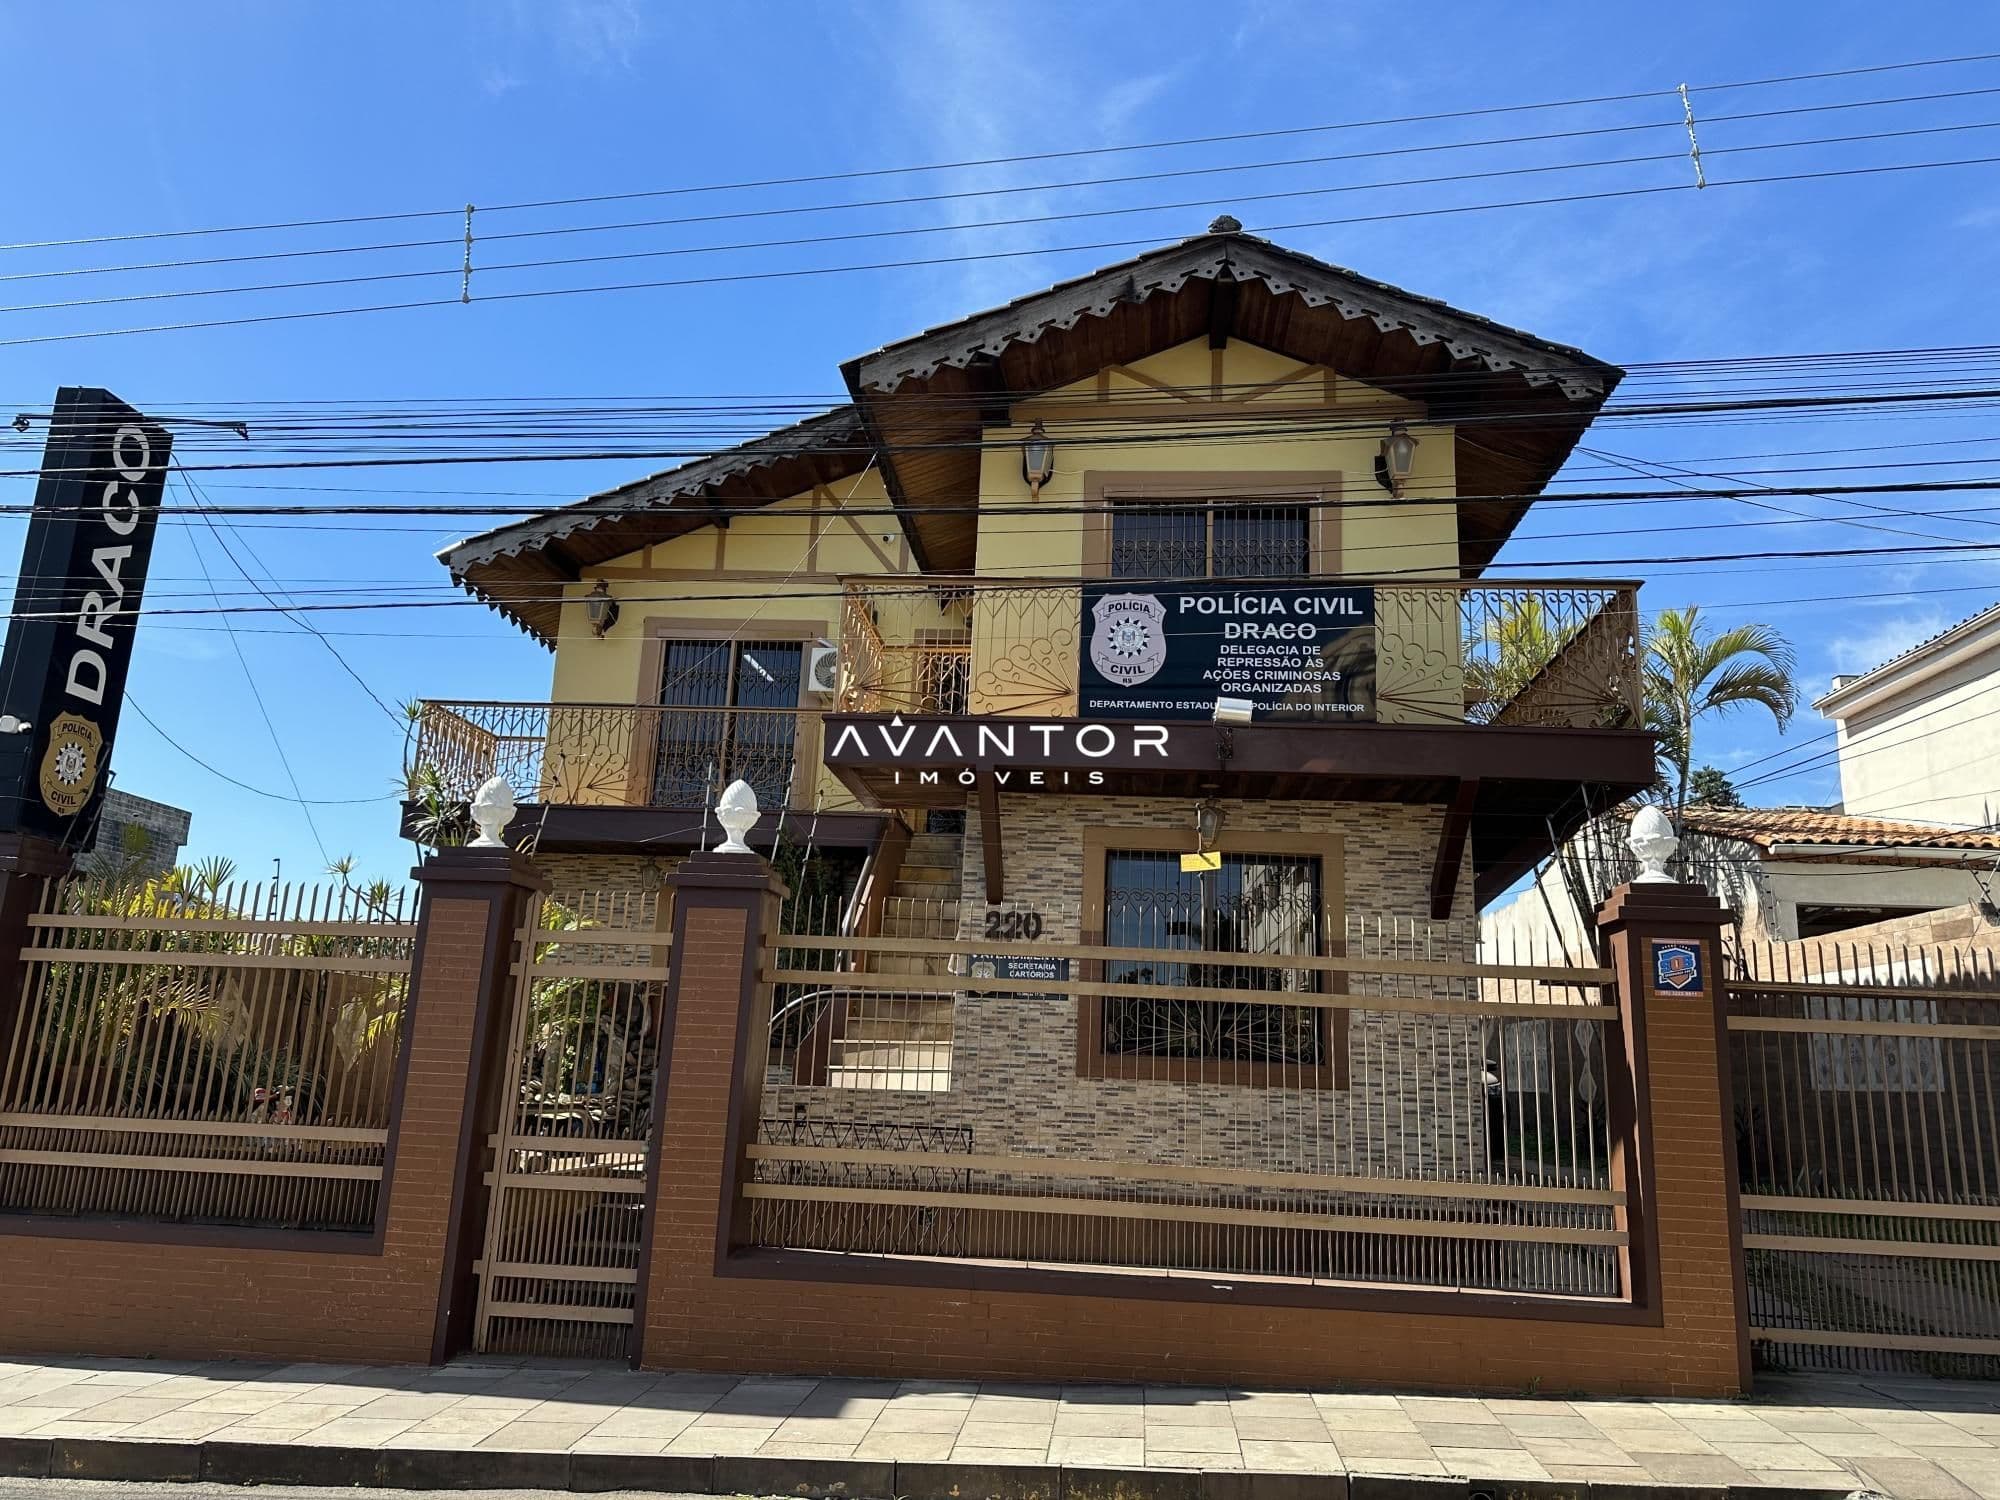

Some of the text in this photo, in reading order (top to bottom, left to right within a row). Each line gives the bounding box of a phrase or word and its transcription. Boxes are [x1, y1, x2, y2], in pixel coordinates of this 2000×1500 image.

[66, 425, 150, 706] DRACO
[1179, 593, 1364, 615] POLÍCIA CIVIL
[1224, 622, 1317, 640] DRACO
[1220, 645, 1321, 655] DELEGACIA DE
[1217, 656, 1302, 668] REPRESSÃO
[1110, 664, 1146, 675] CIVIL
[1203, 668, 1341, 682] AÇÕES CRIMINOSAS
[1221, 682, 1322, 694] ORGANIZADAS
[1089, 700, 1365, 712] DEPARTAMENTO ESTADU POLÍCIA DO INTERIOR
[50, 791, 77, 805] CIVIL
[985, 911, 1042, 939] 220
[1008, 962, 1057, 970] SECRETARIA
